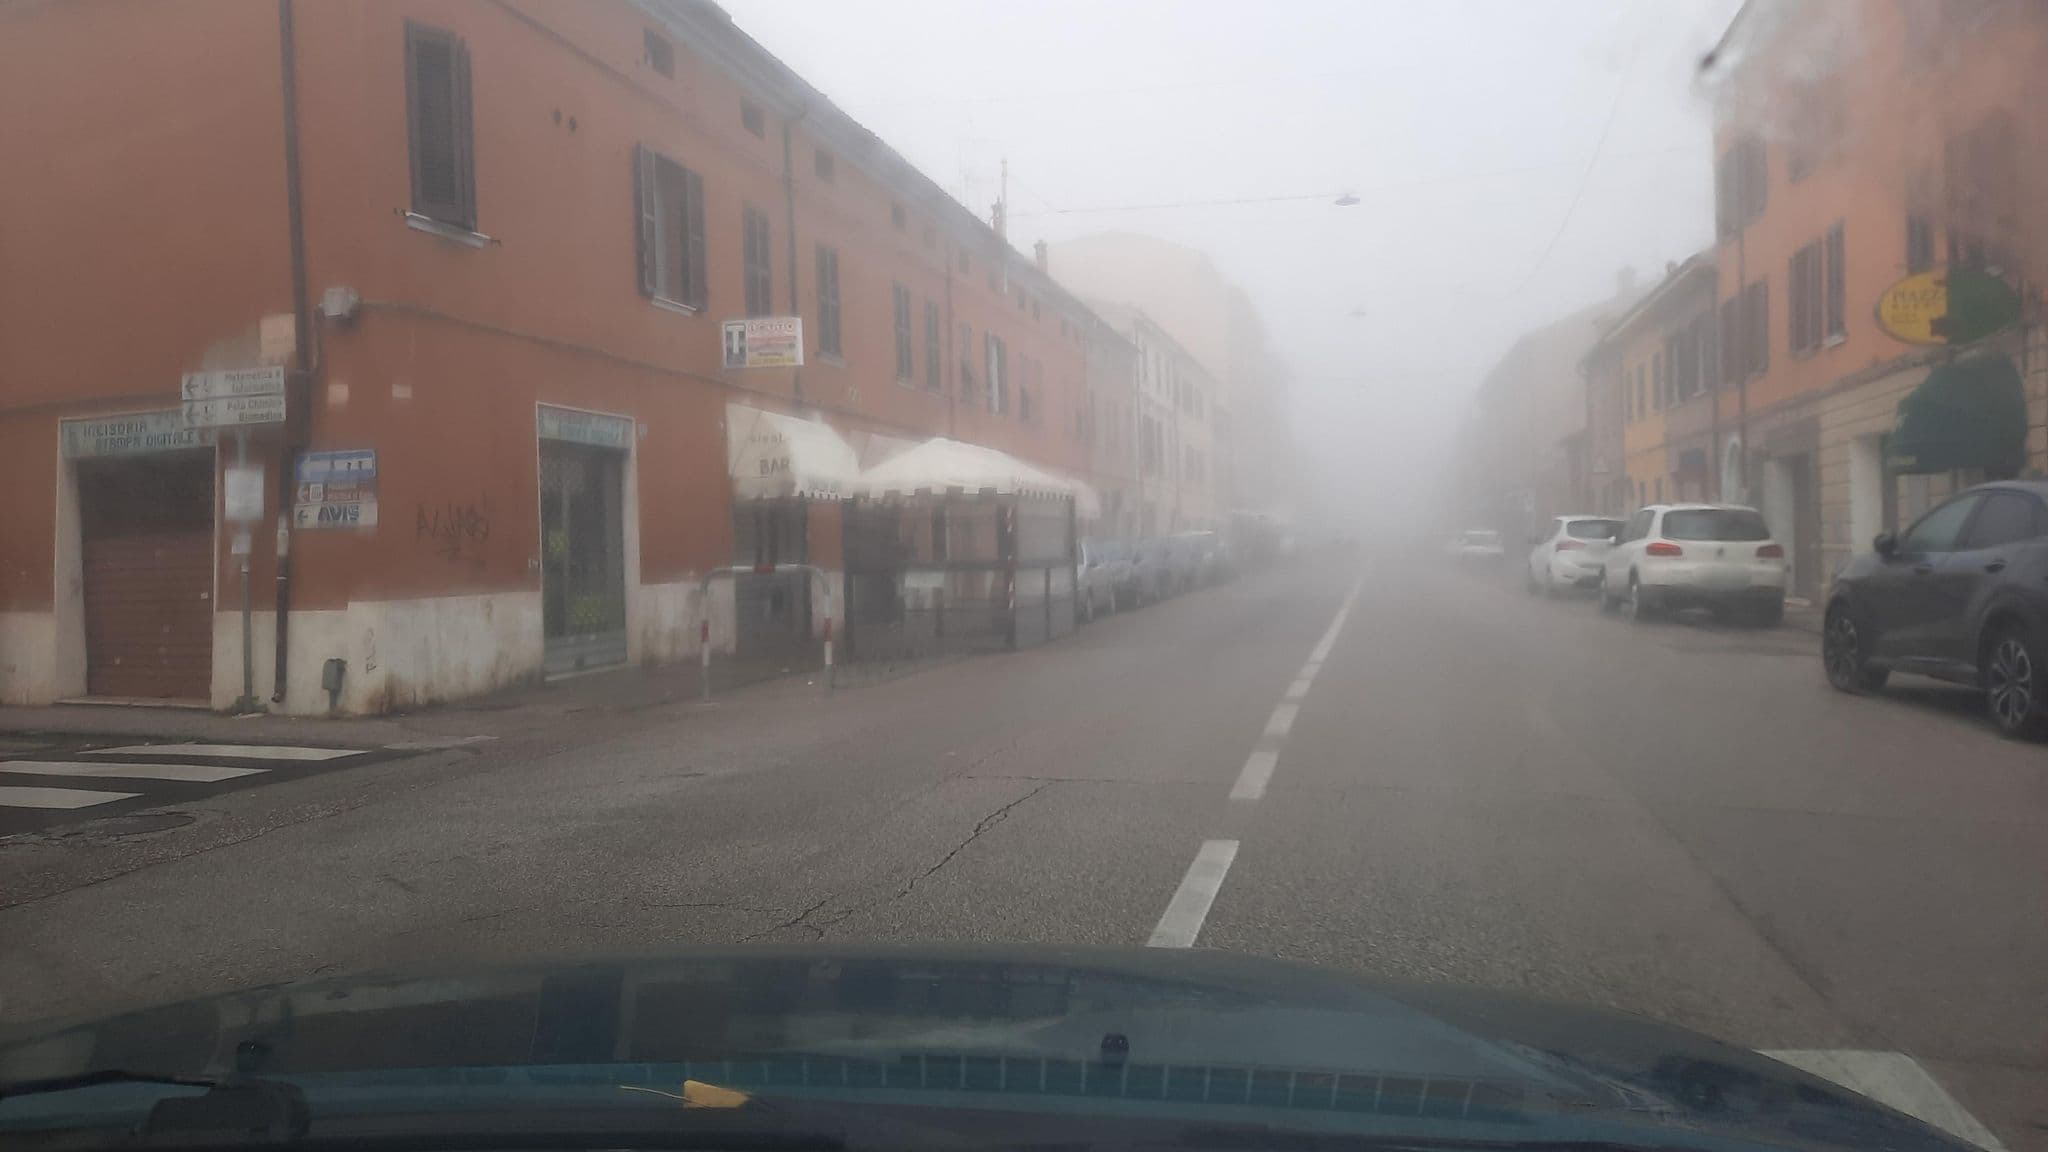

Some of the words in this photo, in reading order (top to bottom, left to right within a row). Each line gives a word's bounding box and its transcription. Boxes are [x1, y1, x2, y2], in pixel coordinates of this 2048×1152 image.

[146, 431, 194, 447] DIGITALE
[760, 457, 790, 474] BAR
[318, 503, 360, 521] AVIS
